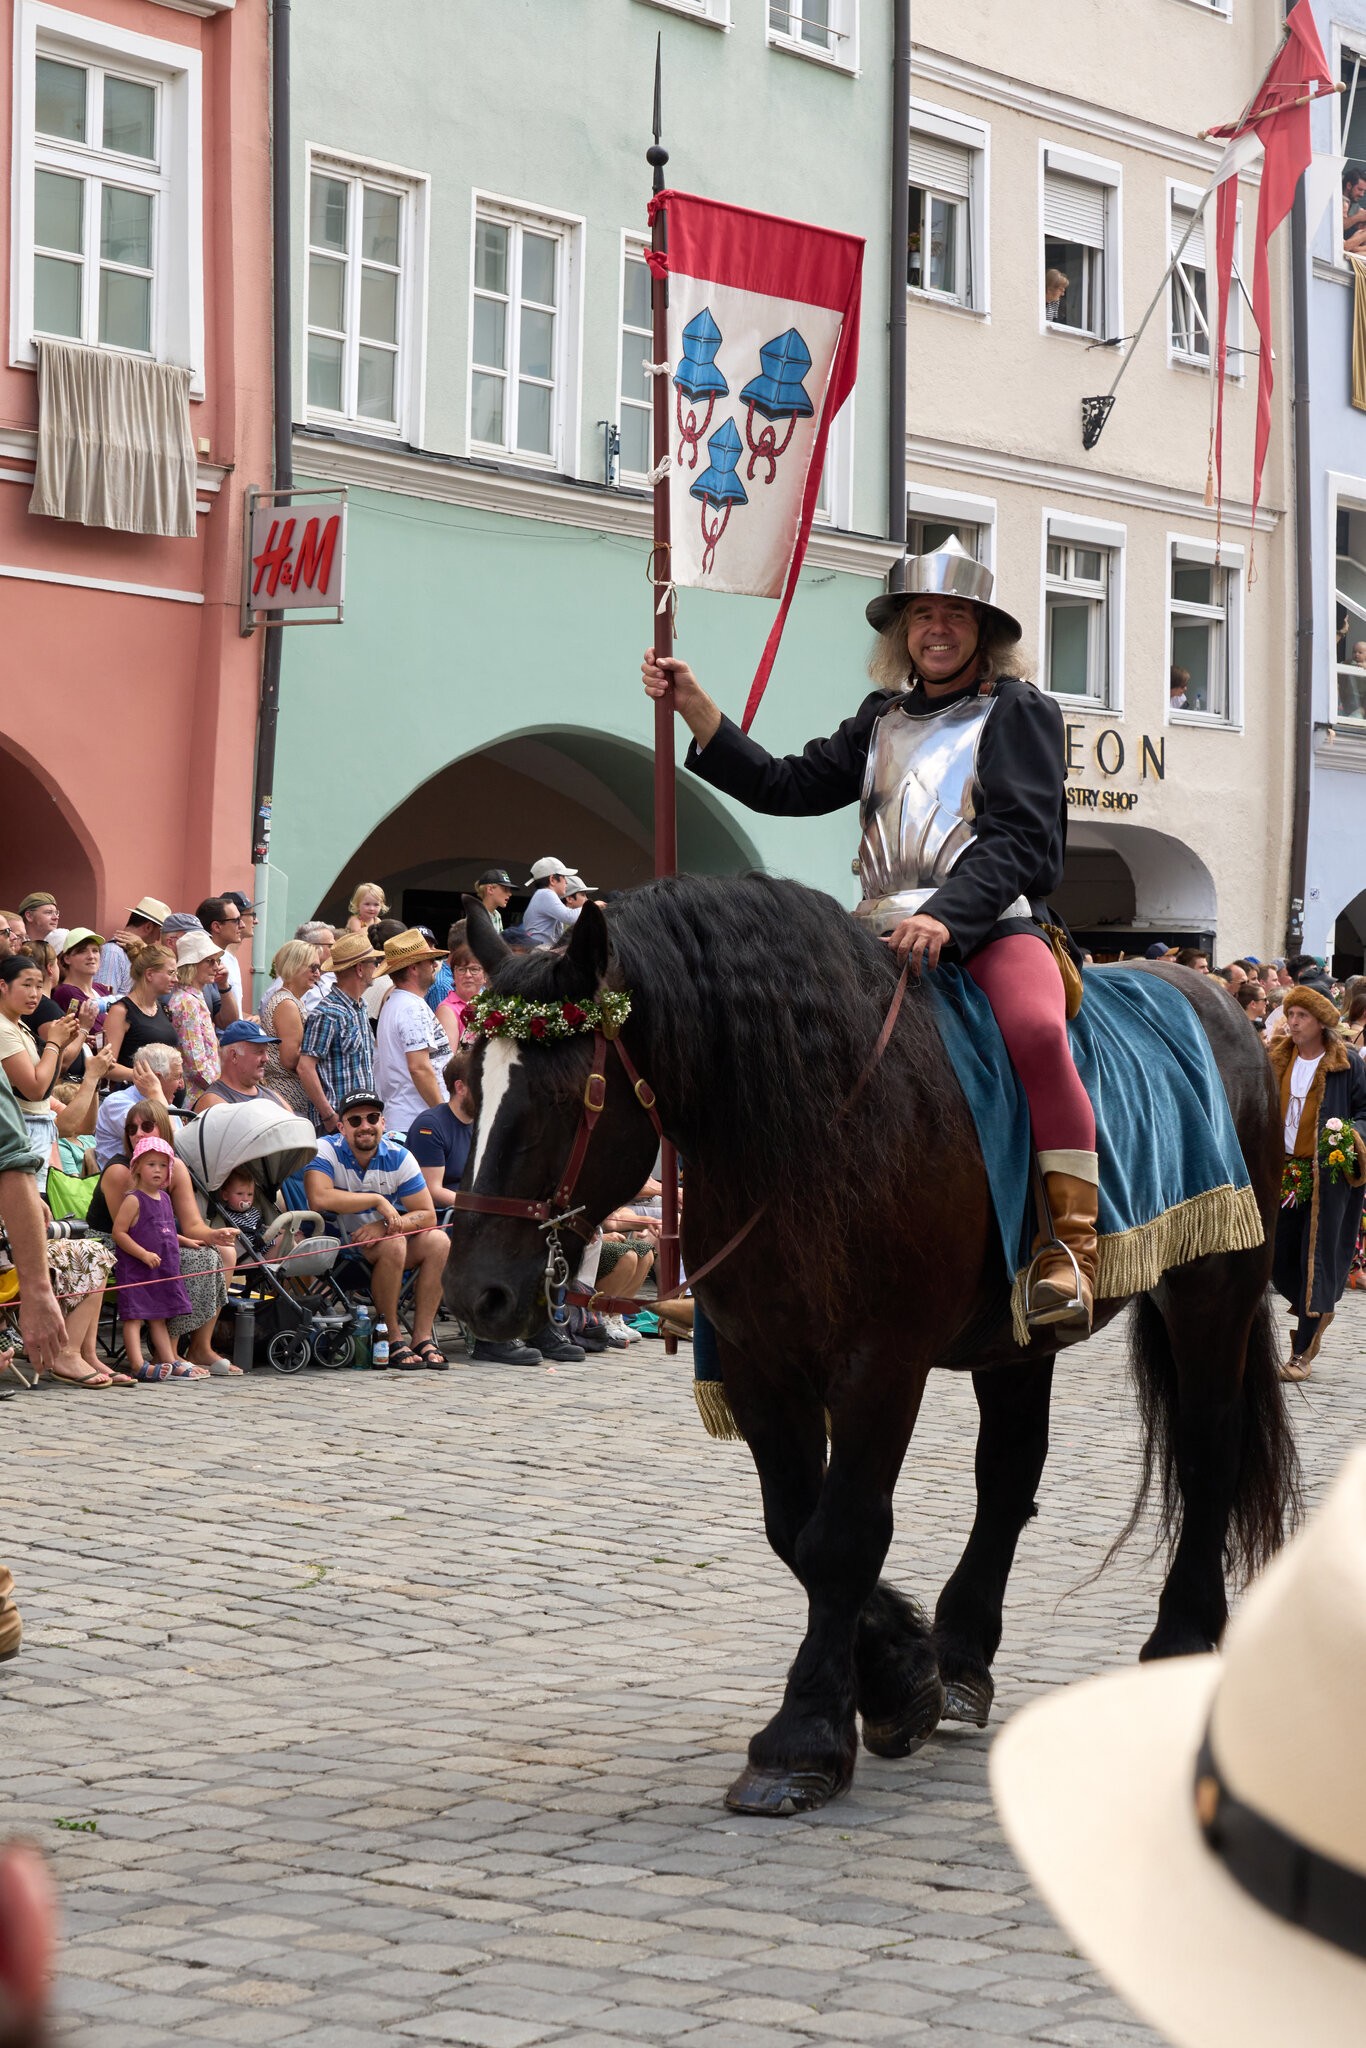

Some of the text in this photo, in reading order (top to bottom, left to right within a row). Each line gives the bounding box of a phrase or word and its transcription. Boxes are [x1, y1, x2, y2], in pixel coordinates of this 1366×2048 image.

[252, 515, 340, 597] H&M
[1102, 790, 1138, 811] SHOP
[345, 1093, 376, 1103] CCM
